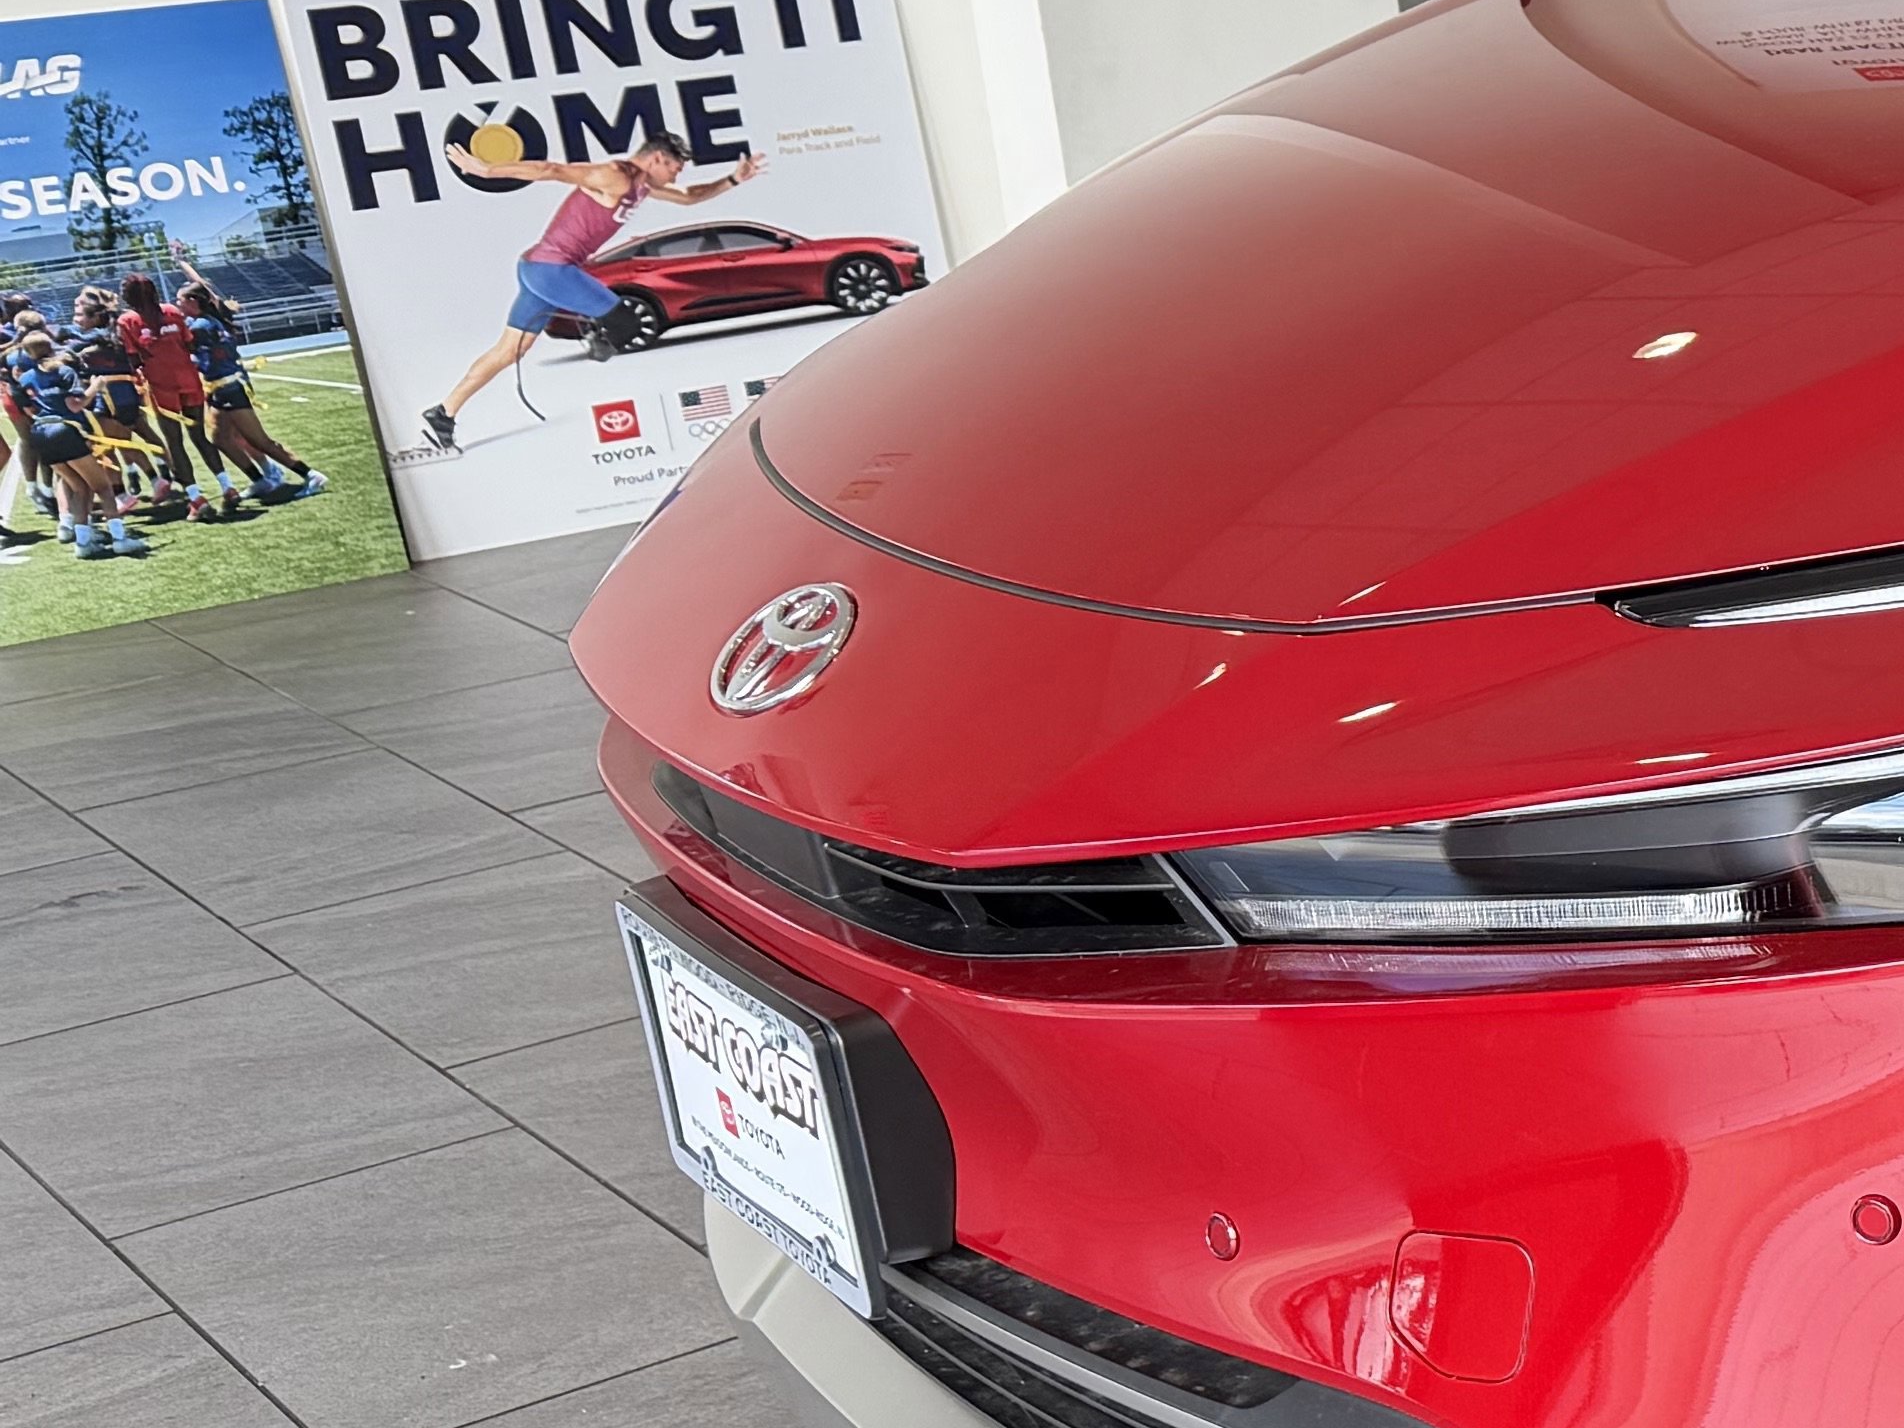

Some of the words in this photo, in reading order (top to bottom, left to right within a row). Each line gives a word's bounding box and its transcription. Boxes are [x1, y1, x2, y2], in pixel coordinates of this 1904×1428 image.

[0, 53, 83, 99] AG
[331, 74, 752, 213] HOME
[0, 156, 247, 220] SEASON.
[592, 445, 656, 466] TOYOTA
[613, 469, 654, 487] Proud
[657, 465, 689, 478] Part
[666, 974, 723, 1074] EAST
[721, 1018, 821, 1141] COAST
[737, 1113, 786, 1160] TOYOTA
[702, 1169, 733, 1209] EAST
[735, 1197, 781, 1244] COAST
[778, 1233, 832, 1285] TOYOTA
